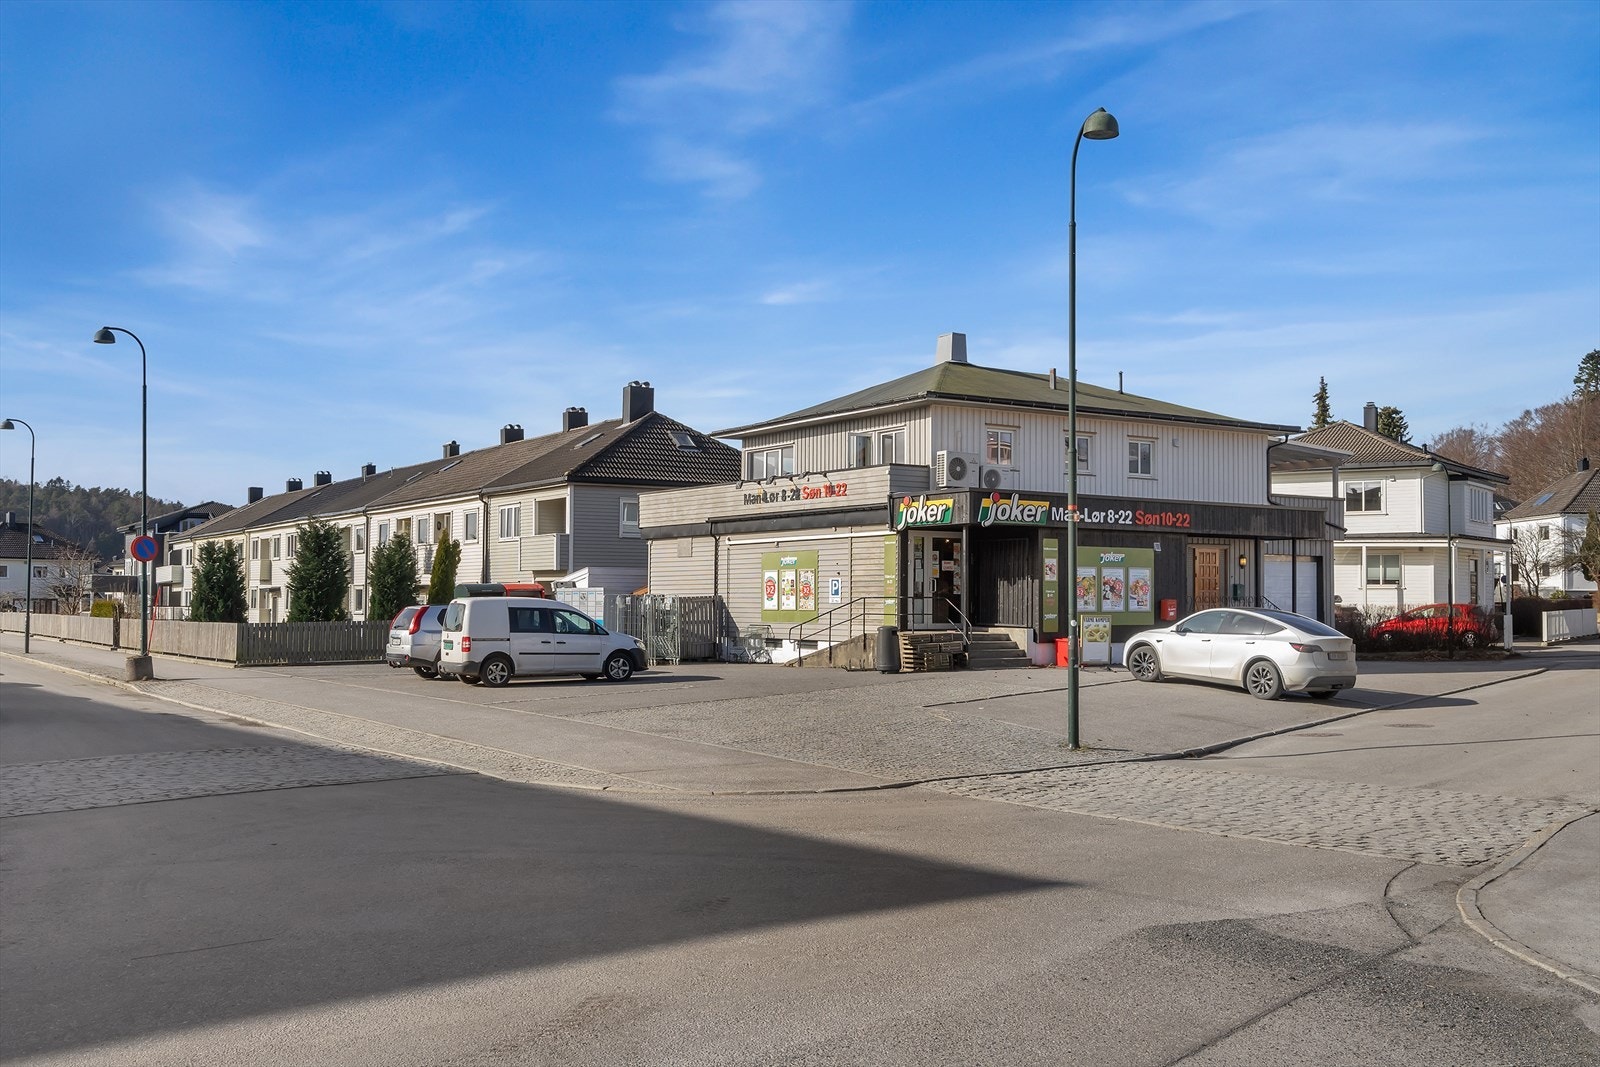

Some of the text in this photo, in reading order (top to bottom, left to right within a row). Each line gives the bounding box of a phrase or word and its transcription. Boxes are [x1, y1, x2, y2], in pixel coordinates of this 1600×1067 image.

[743, 489, 779, 505] ManLør
[801, 486, 821, 500] Søn
[823, 483, 848, 498] 1022
[897, 494, 947, 530] joker
[981, 492, 1047, 527] joker
[1107, 509, 1133, 524] 8-22
[1135, 510, 1160, 525] Søn
[1160, 512, 1191, 527] 10-22
[832, 580, 839, 595] P
